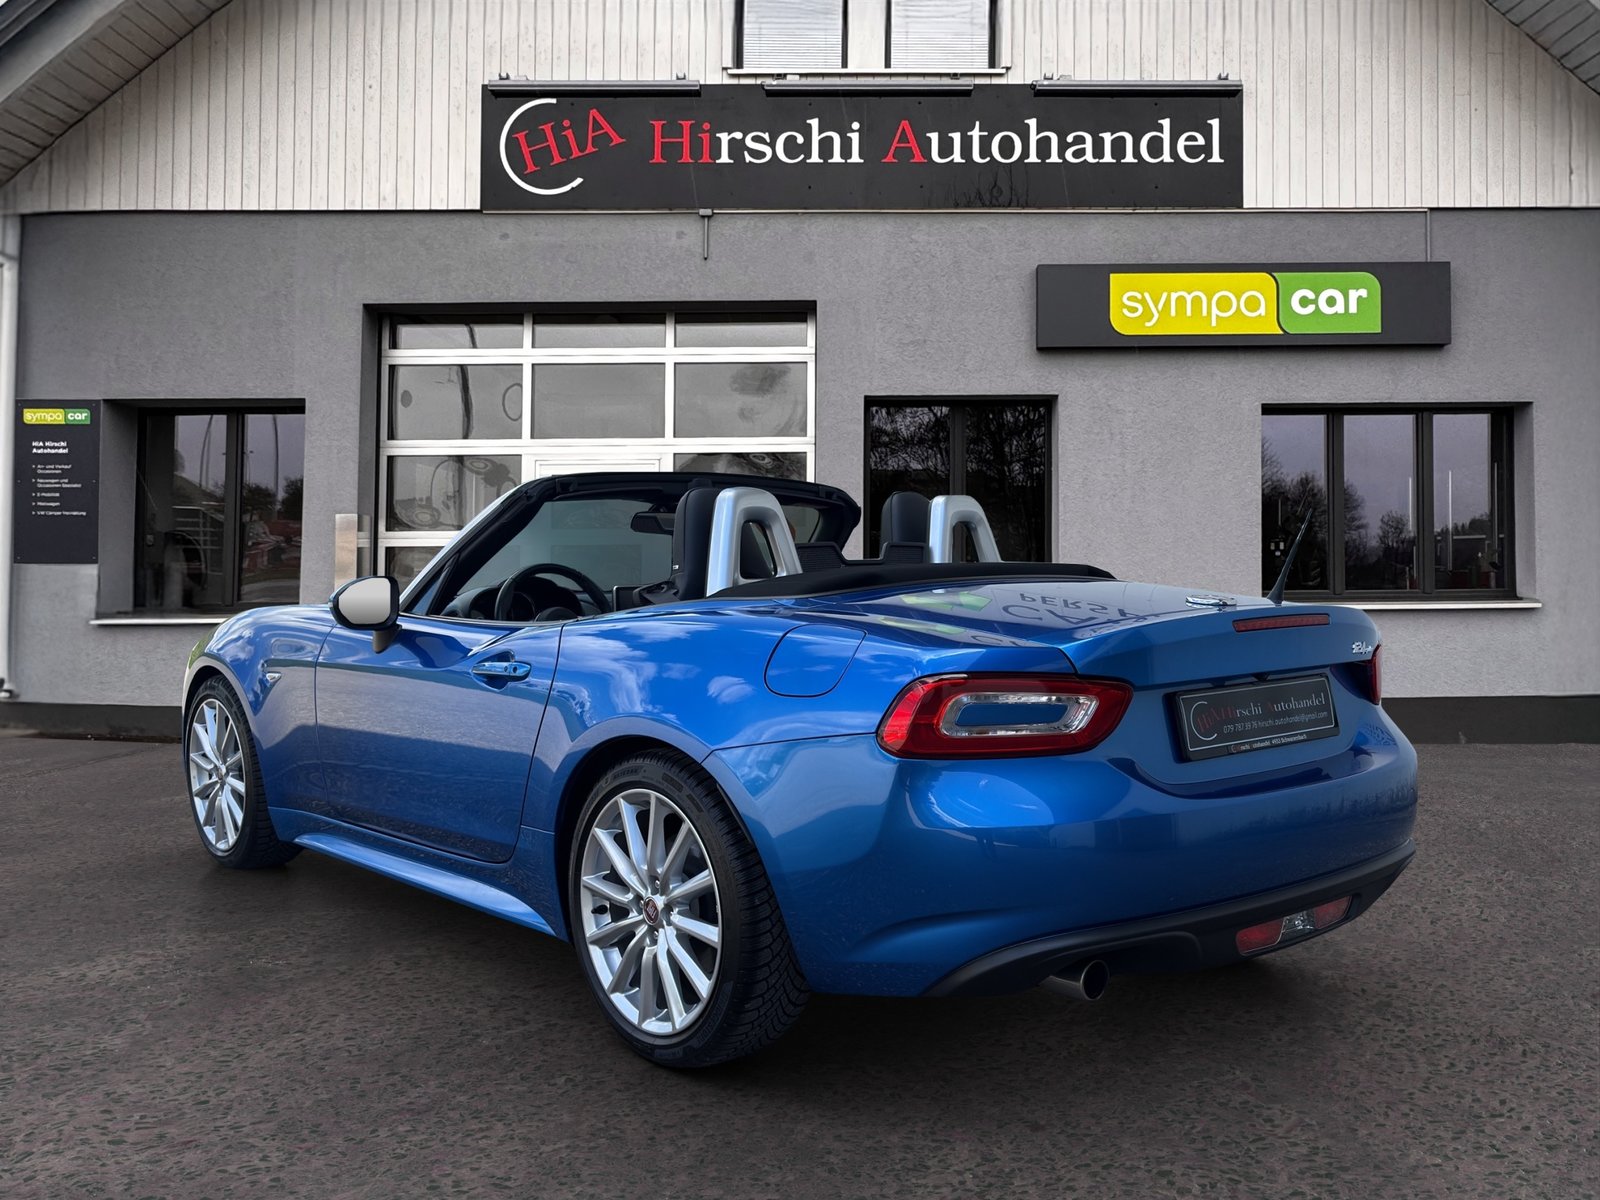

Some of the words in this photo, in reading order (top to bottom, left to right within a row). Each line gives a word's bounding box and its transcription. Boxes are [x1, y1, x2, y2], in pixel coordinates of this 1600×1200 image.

[511, 108, 627, 175] HiA
[649, 117, 865, 165] Hirschi
[881, 117, 1225, 165] Autohandel
[1121, 289, 1266, 327] sympa
[1290, 287, 1368, 315] car
[25, 412, 63, 422] sympa
[67, 412, 88, 420] car
